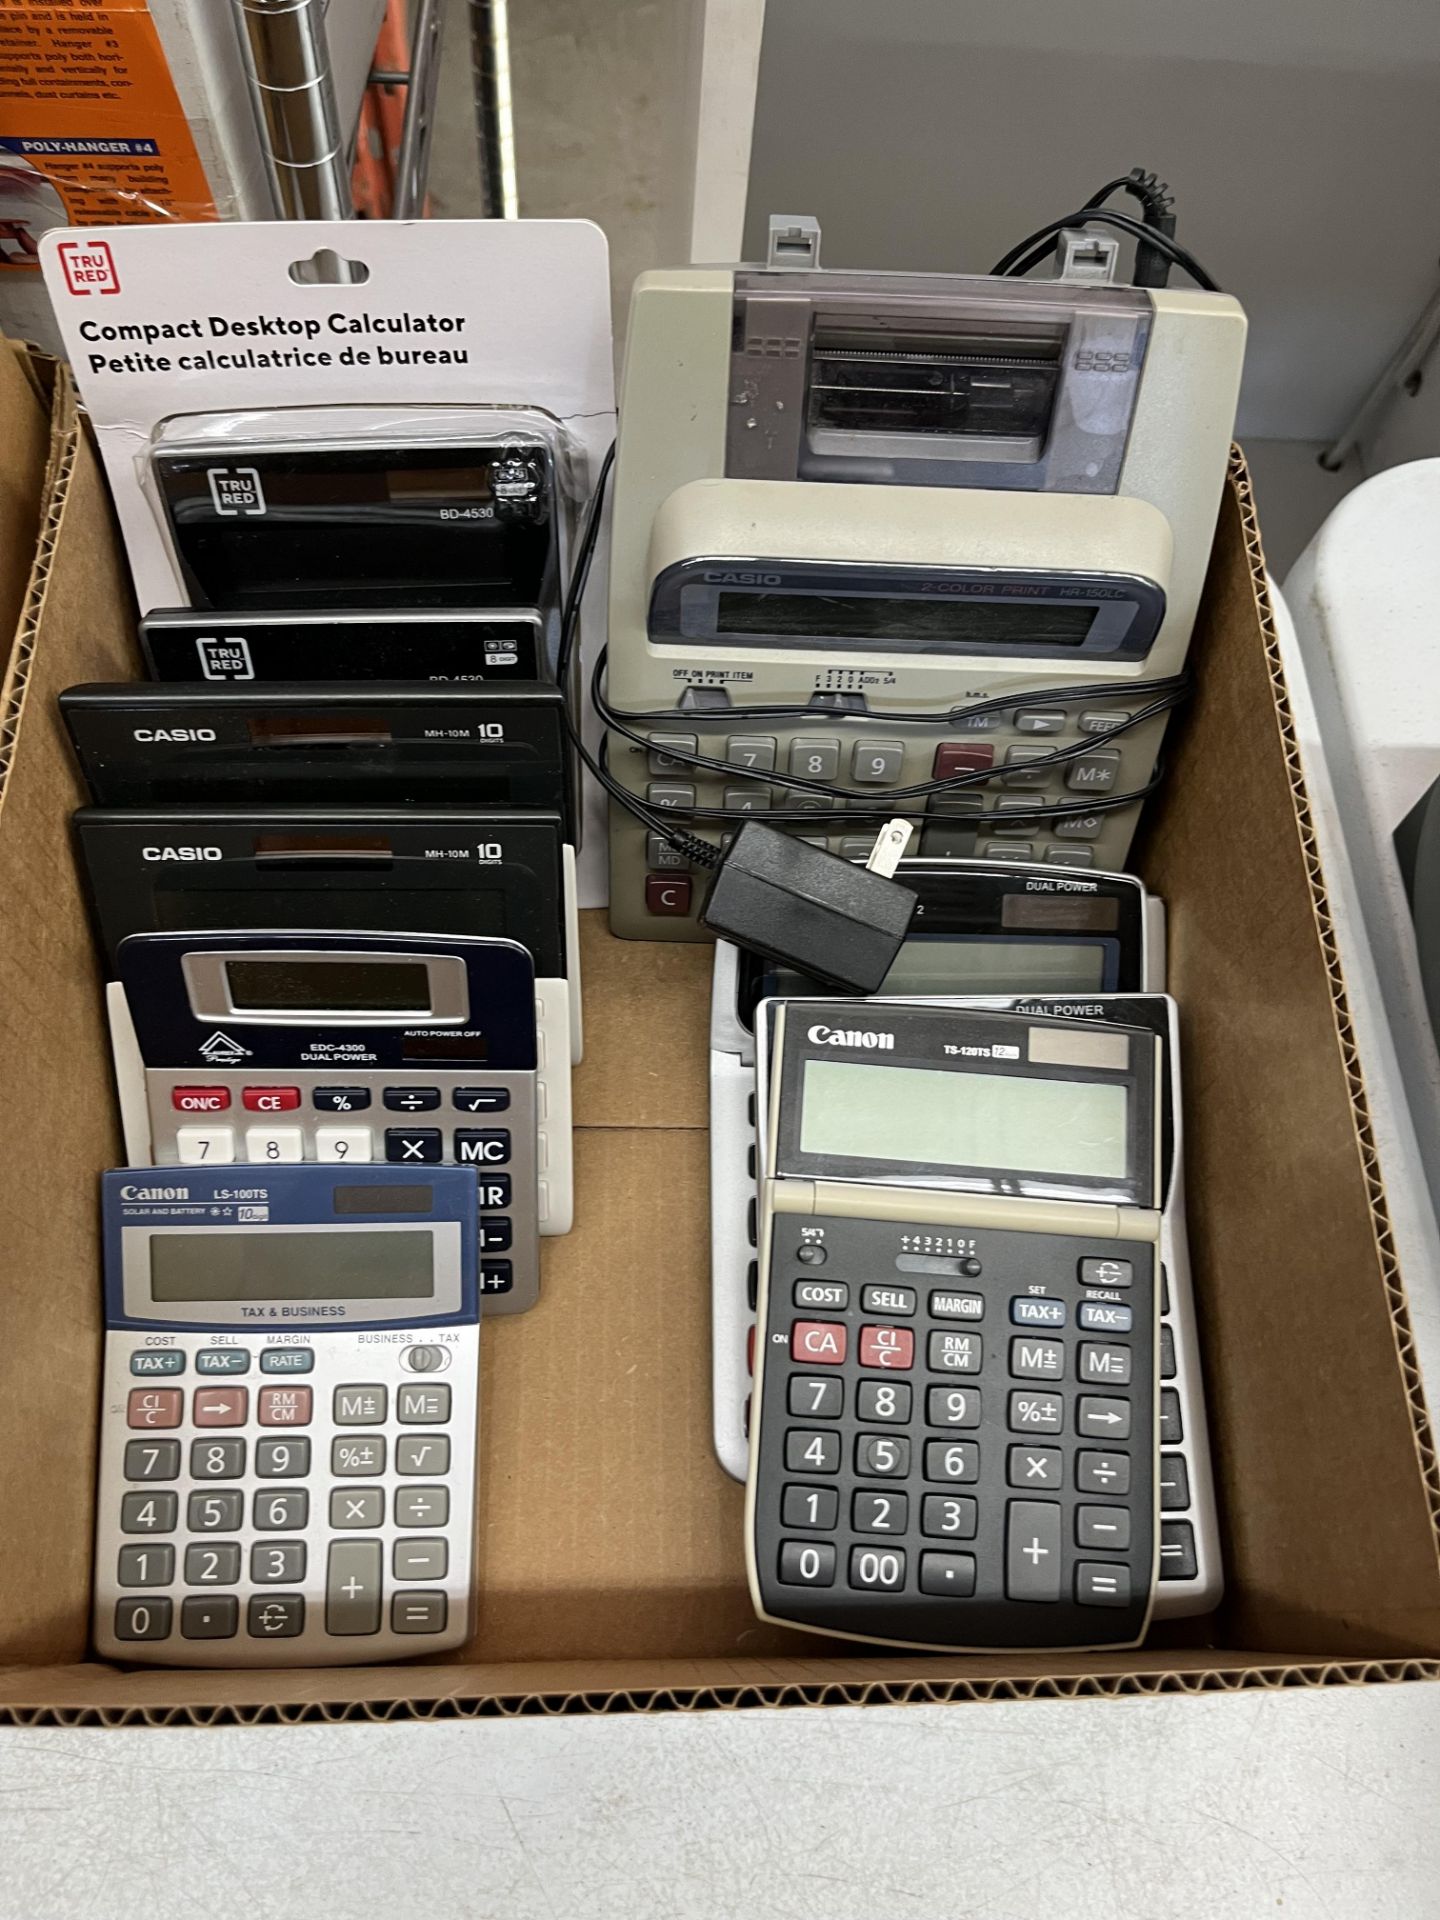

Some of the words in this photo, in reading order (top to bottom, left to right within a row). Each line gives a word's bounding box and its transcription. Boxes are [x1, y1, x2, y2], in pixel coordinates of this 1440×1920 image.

[10, 11, 28, 21] pin
[32, 11, 52, 20] and
[57, 11, 66, 20] is
[70, 11, 95, 20] held
[98, 12, 109, 20] in
[27, 25, 40, 36] by
[57, 25, 113, 35] removable
[51, 40, 92, 50] Hanger
[106, 40, 119, 48] #3
[45, 53, 67, 63] poly
[70, 53, 95, 61] both
[61, 66, 107, 75] vertically
[113, 66, 127, 74] for
[22, 141, 131, 153] POLY-HANGER
[135, 144, 153, 153] #4
[44, 162, 79, 171] Hanger
[70, 255, 104, 268] TRU
[74, 270, 108, 283] RED
[79, 319, 203, 345] Compact
[208, 314, 321, 340] Desktop
[327, 313, 465, 334] Calculator
[88, 352, 171, 374] Petite
[179, 347, 332, 370] calculatrice
[339, 346, 371, 366] de
[377, 346, 469, 366] bureau
[219, 480, 252, 492] TRU
[222, 493, 255, 504] RED
[440, 507, 494, 519] BD-4530
[704, 572, 782, 585] CASIO
[921, 582, 994, 594] 2-COLOR
[1002, 585, 1048, 596] PRINT
[1059, 587, 1127, 599] HR-150LC
[208, 648, 241, 659] TRU
[490, 655, 498, 664] 8
[211, 660, 243, 670] RED
[673, 669, 689, 678] OFF
[692, 670, 704, 679] ON
[706, 671, 730, 679] PRINT
[733, 672, 753, 680] ITEM
[133, 728, 216, 742] CASIO
[424, 730, 470, 738] MH-10M
[477, 723, 504, 738] 10
[743, 753, 757, 767] 7
[808, 756, 823, 773] 8
[871, 757, 886, 775] 9
[142, 847, 223, 861] CASIO
[425, 850, 470, 858] MH-10M
[477, 843, 502, 859] 10
[659, 855, 681, 865] MD
[1026, 881, 1054, 891] DUAL
[1056, 882, 1098, 892] POWER
[661, 890, 676, 905] C
[1016, 1005, 1050, 1015] DUAL
[1054, 1005, 1104, 1016] POWER
[807, 1025, 895, 1050] Canon
[310, 1043, 366, 1052] EDC-4300
[943, 1044, 991, 1057] TS-120TS
[301, 1053, 332, 1061] DUAL
[334, 1053, 378, 1062] POWER
[181, 1096, 221, 1110] ON/C
[257, 1096, 281, 1110] CE
[197, 1141, 210, 1159] 7
[266, 1141, 280, 1159] 8
[334, 1141, 349, 1159] 9
[461, 1141, 504, 1161] MC
[120, 1185, 189, 1200] Canon
[213, 1188, 269, 1199] LS-100TS
[123, 1207, 149, 1216] SOLAR
[152, 1207, 169, 1215] AND
[171, 1206, 206, 1215] BATTERY
[913, 1235, 920, 1245] 4
[924, 1236, 932, 1246] 3
[935, 1237, 943, 1247] 2
[947, 1238, 953, 1247] 1
[957, 1239, 965, 1249] 0
[968, 1240, 976, 1248] F
[1028, 1285, 1047, 1295] SET
[1086, 1290, 1122, 1300] RECALL
[802, 1287, 843, 1303] COST
[871, 1291, 907, 1308] SELL
[934, 1296, 982, 1314] MARGIN
[241, 1307, 265, 1317] TAX
[268, 1307, 277, 1317] &
[281, 1306, 346, 1317] BUSINESS
[145, 1336, 176, 1346] COST
[210, 1336, 239, 1346] SELL
[266, 1334, 311, 1345] MARGIN
[357, 1334, 414, 1344] BUSINESS
[438, 1333, 460, 1343] TAX
[772, 1334, 789, 1344] ON
[805, 1331, 838, 1353] CA
[944, 1337, 969, 1350] RM
[269, 1354, 303, 1367] RATE
[879, 1351, 891, 1366] C
[943, 1353, 969, 1367] CM
[271, 1393, 295, 1405] RM
[809, 1382, 827, 1410] 7
[875, 1387, 896, 1416] 8
[947, 1393, 966, 1421] 9
[145, 1411, 156, 1424] C
[271, 1408, 295, 1421] CM
[142, 1449, 160, 1475] 7
[206, 1447, 225, 1473] 8
[271, 1446, 290, 1472] 9
[804, 1437, 825, 1466] 4
[876, 1441, 894, 1470] 5
[944, 1447, 964, 1476] 6
[136, 1500, 157, 1527] 4
[204, 1499, 221, 1526] 5
[269, 1498, 288, 1525] 6
[806, 1493, 819, 1523] 1
[871, 1498, 890, 1528] 2
[941, 1501, 961, 1531] 3
[136, 1553, 147, 1581] 1
[201, 1552, 219, 1579] 2
[267, 1550, 285, 1577] 3
[799, 1549, 819, 1579] 0
[859, 1553, 899, 1585] 00
[131, 1607, 150, 1634] 0
